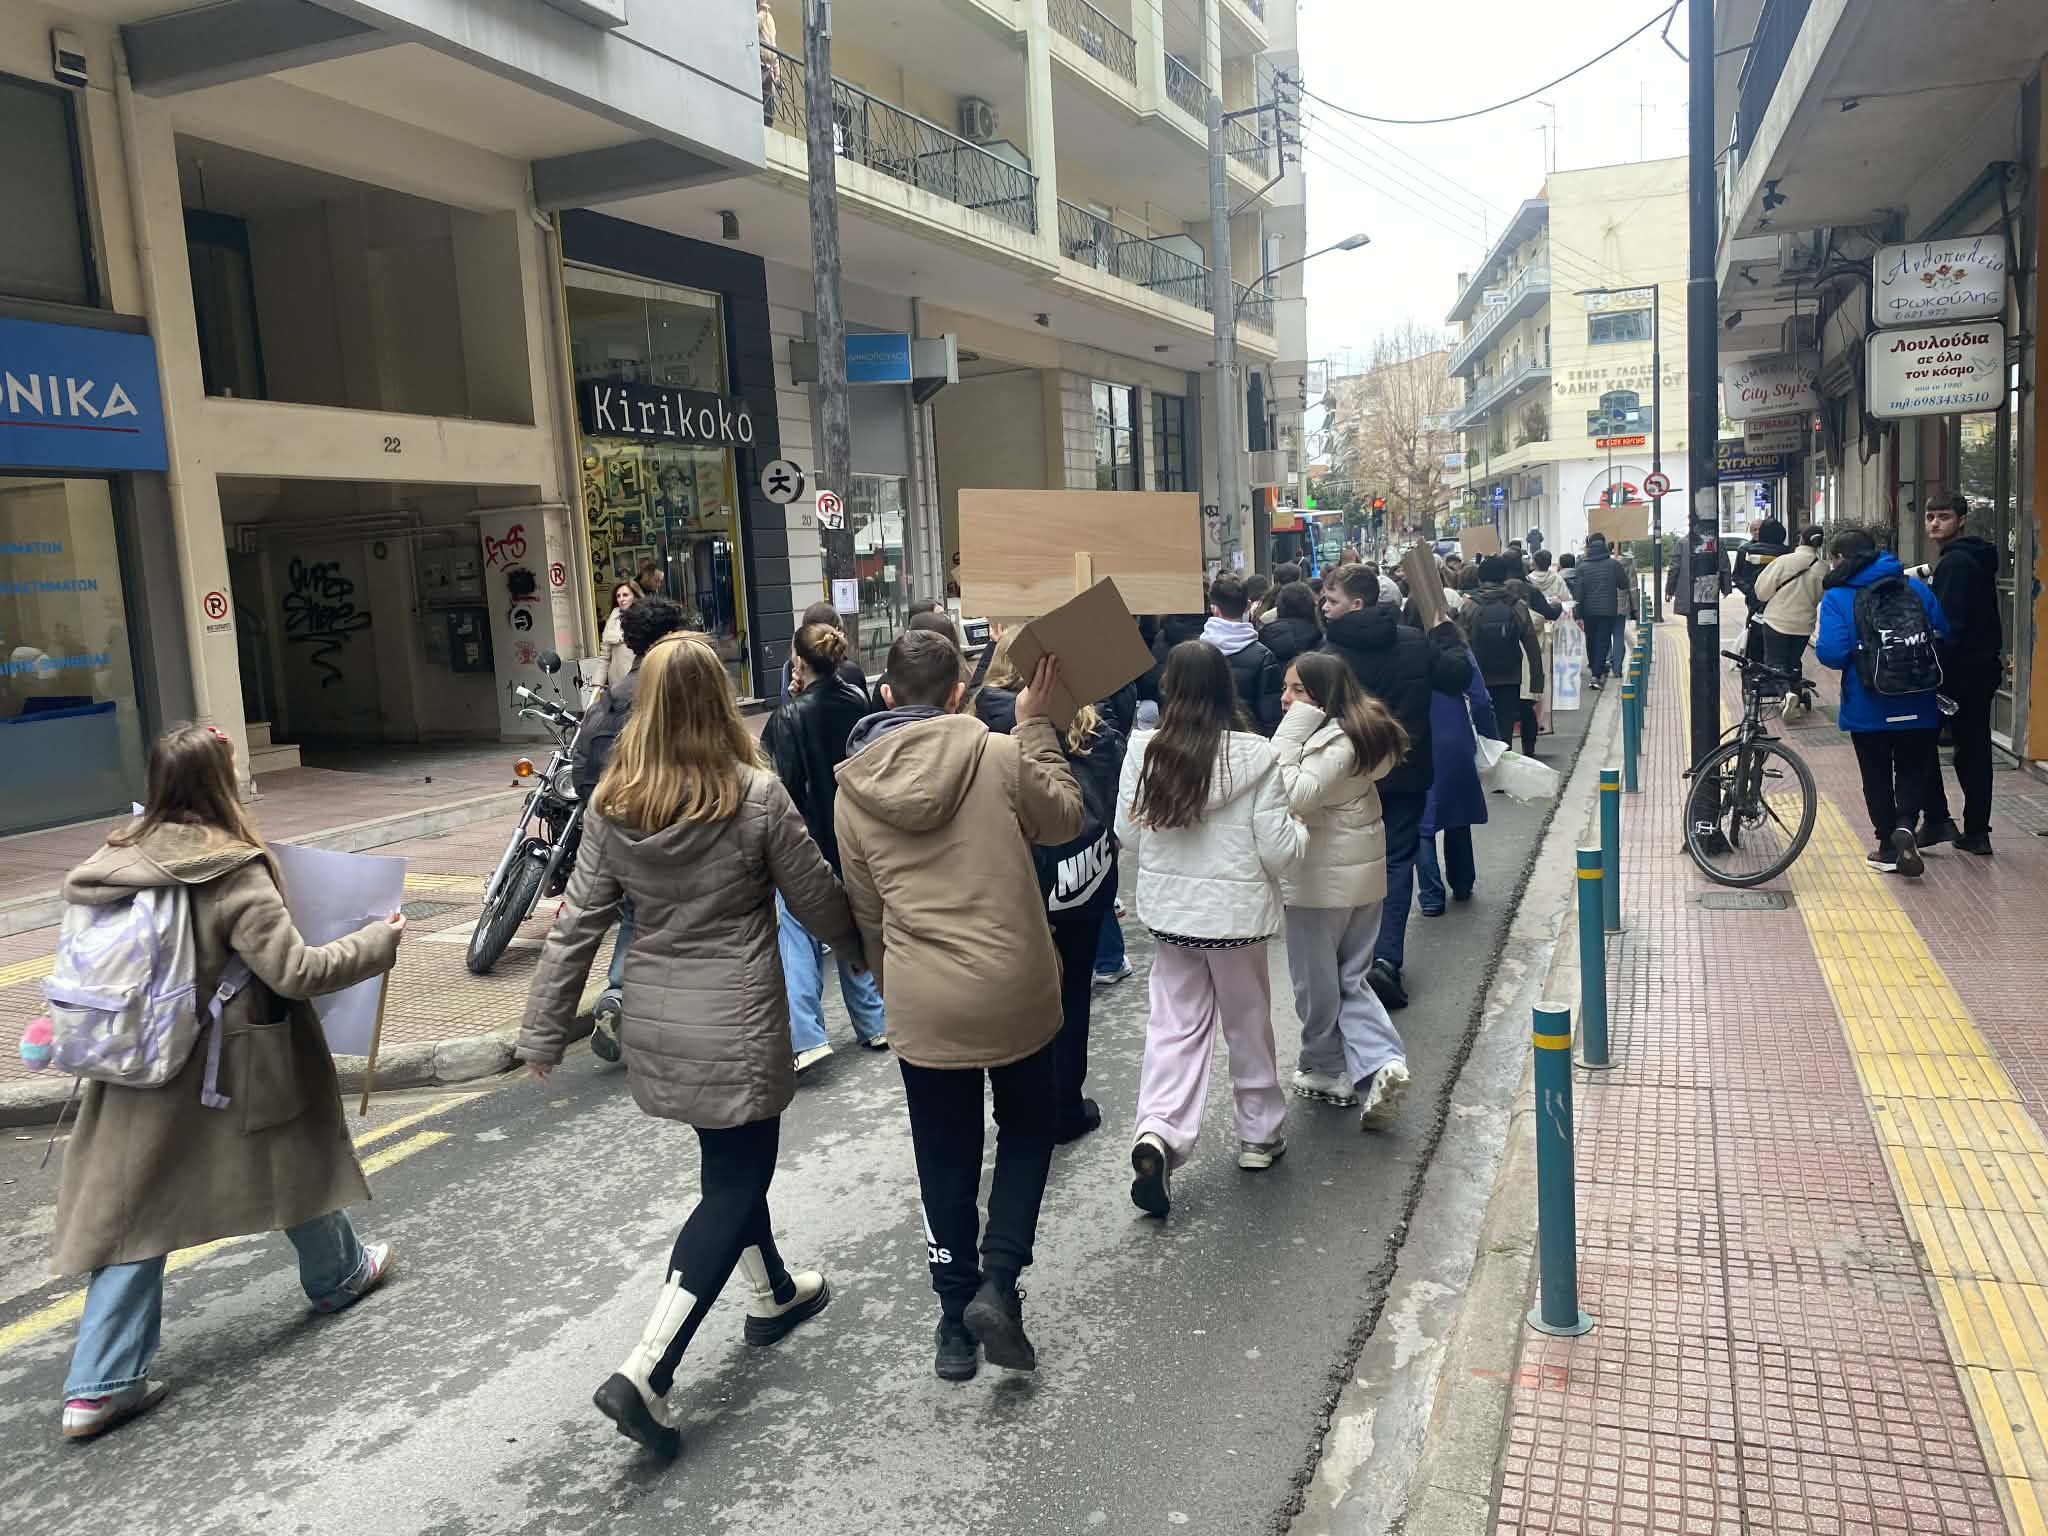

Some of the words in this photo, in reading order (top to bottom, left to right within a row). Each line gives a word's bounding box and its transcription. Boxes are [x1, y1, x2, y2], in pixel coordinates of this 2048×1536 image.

[1890, 332, 1989, 353] Λουλούδια
[1917, 355, 1934, 364] σε
[1936, 351, 1962, 362] όλο
[1905, 369, 1928, 379] τον
[1932, 365, 1974, 377] κόσμο
[0, 370, 139, 418] NIKA
[1742, 387, 1768, 404] City
[594, 384, 753, 442] Kirikoko
[384, 436, 401, 453] 22
[802, 514, 812, 526] 20
[1057, 828, 1113, 897] NIKE
